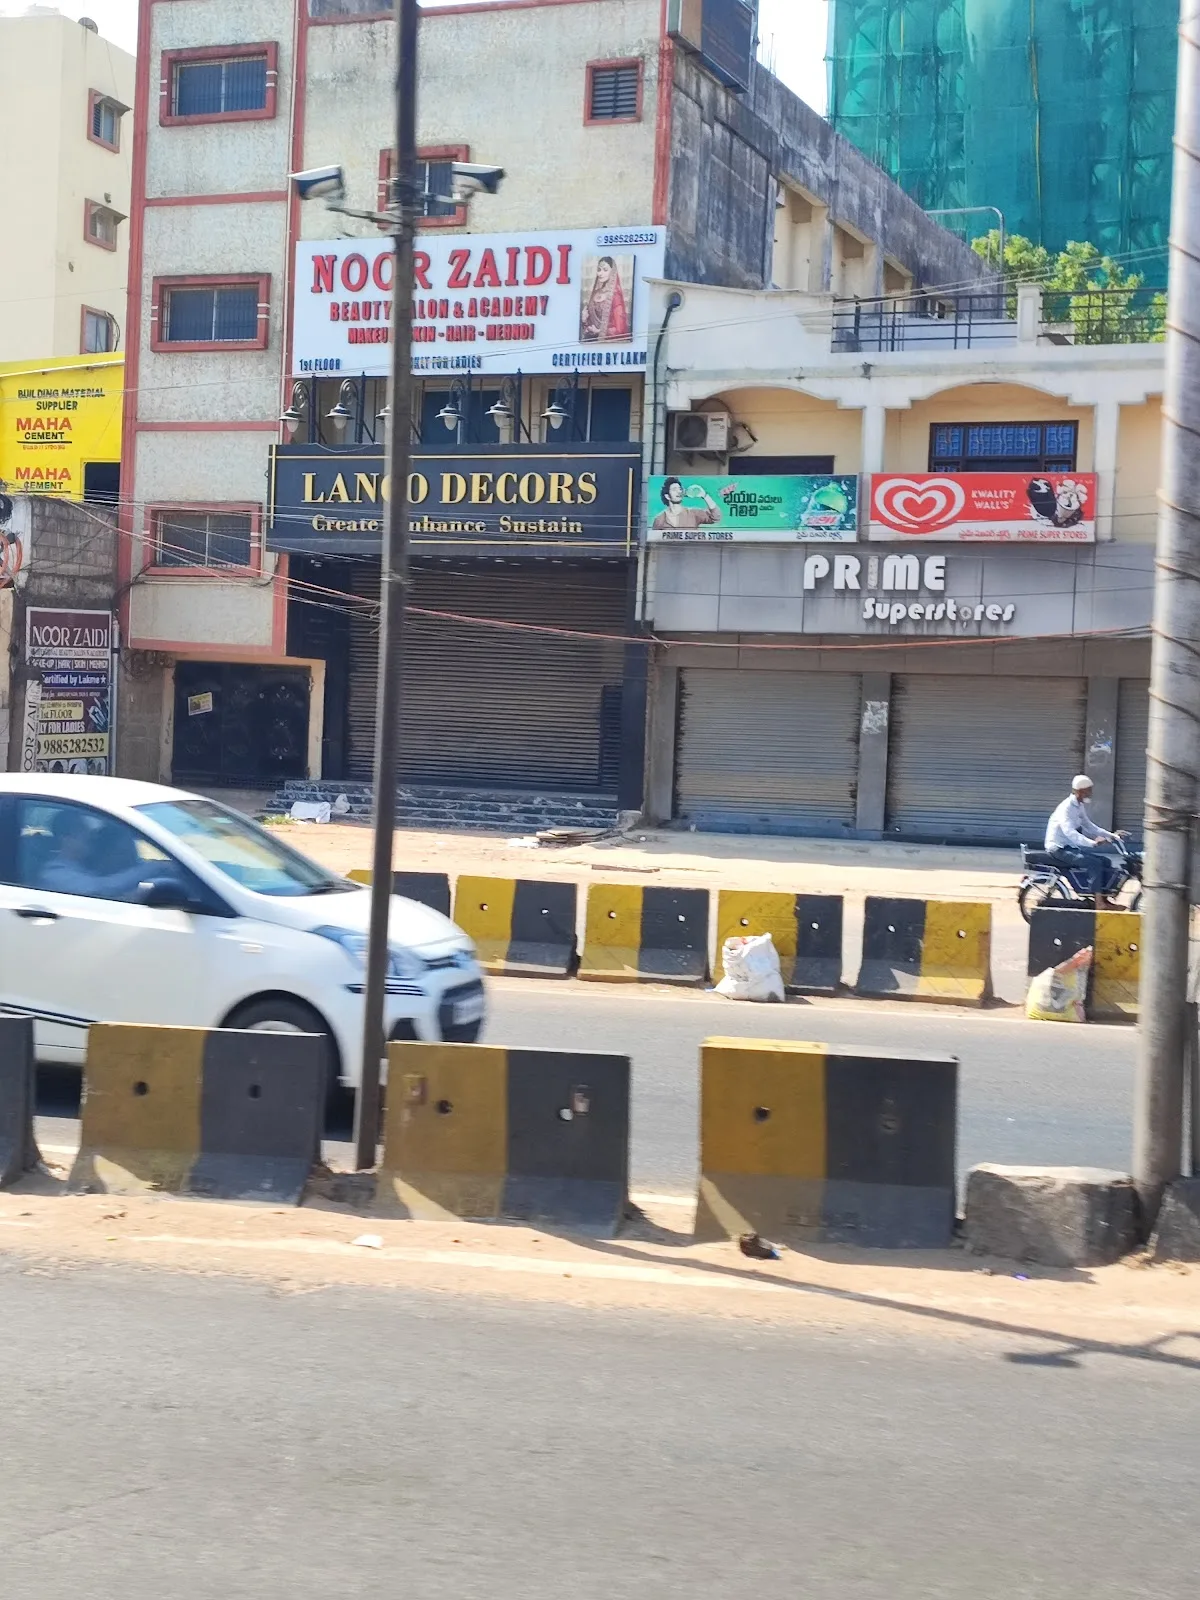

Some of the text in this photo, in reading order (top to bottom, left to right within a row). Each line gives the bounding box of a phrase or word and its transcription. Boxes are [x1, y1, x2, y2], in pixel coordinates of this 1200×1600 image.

[311, 245, 572, 293] NOOR ZAIDI
[330, 295, 549, 321] BEAUTY ALON & ACADEMY
[410, 326, 436, 342] KIN
[446, 325, 476, 342] HAIR
[486, 323, 535, 340] MEHNDI
[314, 358, 341, 370] FLOOR
[432, 356, 449, 369] FOR
[450, 355, 482, 369] LADIES
[552, 351, 647, 367] CERTIFIED BY LAKM
[17, 388, 105, 399] BUILDING MATERIAL
[36, 400, 78, 411] SUPPLIER
[16, 417, 73, 432] MAHA
[24, 432, 65, 441] CEMENT
[15, 467, 72, 481] MAHA
[24, 481, 64, 490] CEMENT
[439, 472, 596, 504] DECORS
[971, 490, 1016, 499] KWALITY
[312, 514, 583, 534] Create nhance Sustain
[662, 531, 734, 541] PRIME SUPER STORES
[1017, 529, 1038, 539] PRIME
[1039, 530, 1061, 539] SUPER
[1063, 530, 1088, 539] STORES
[803, 554, 946, 590] PRIME
[862, 597, 1016, 625] Superstores
[32, 625, 108, 647] NOOR ZAIDI
[42, 674, 100, 686] ertified by Lakme
[48, 722, 61, 732] FOR
[62, 721, 86, 732] LADIES
[43, 738, 105, 754] 9885282532
[23, 737, 35, 771] OOR
